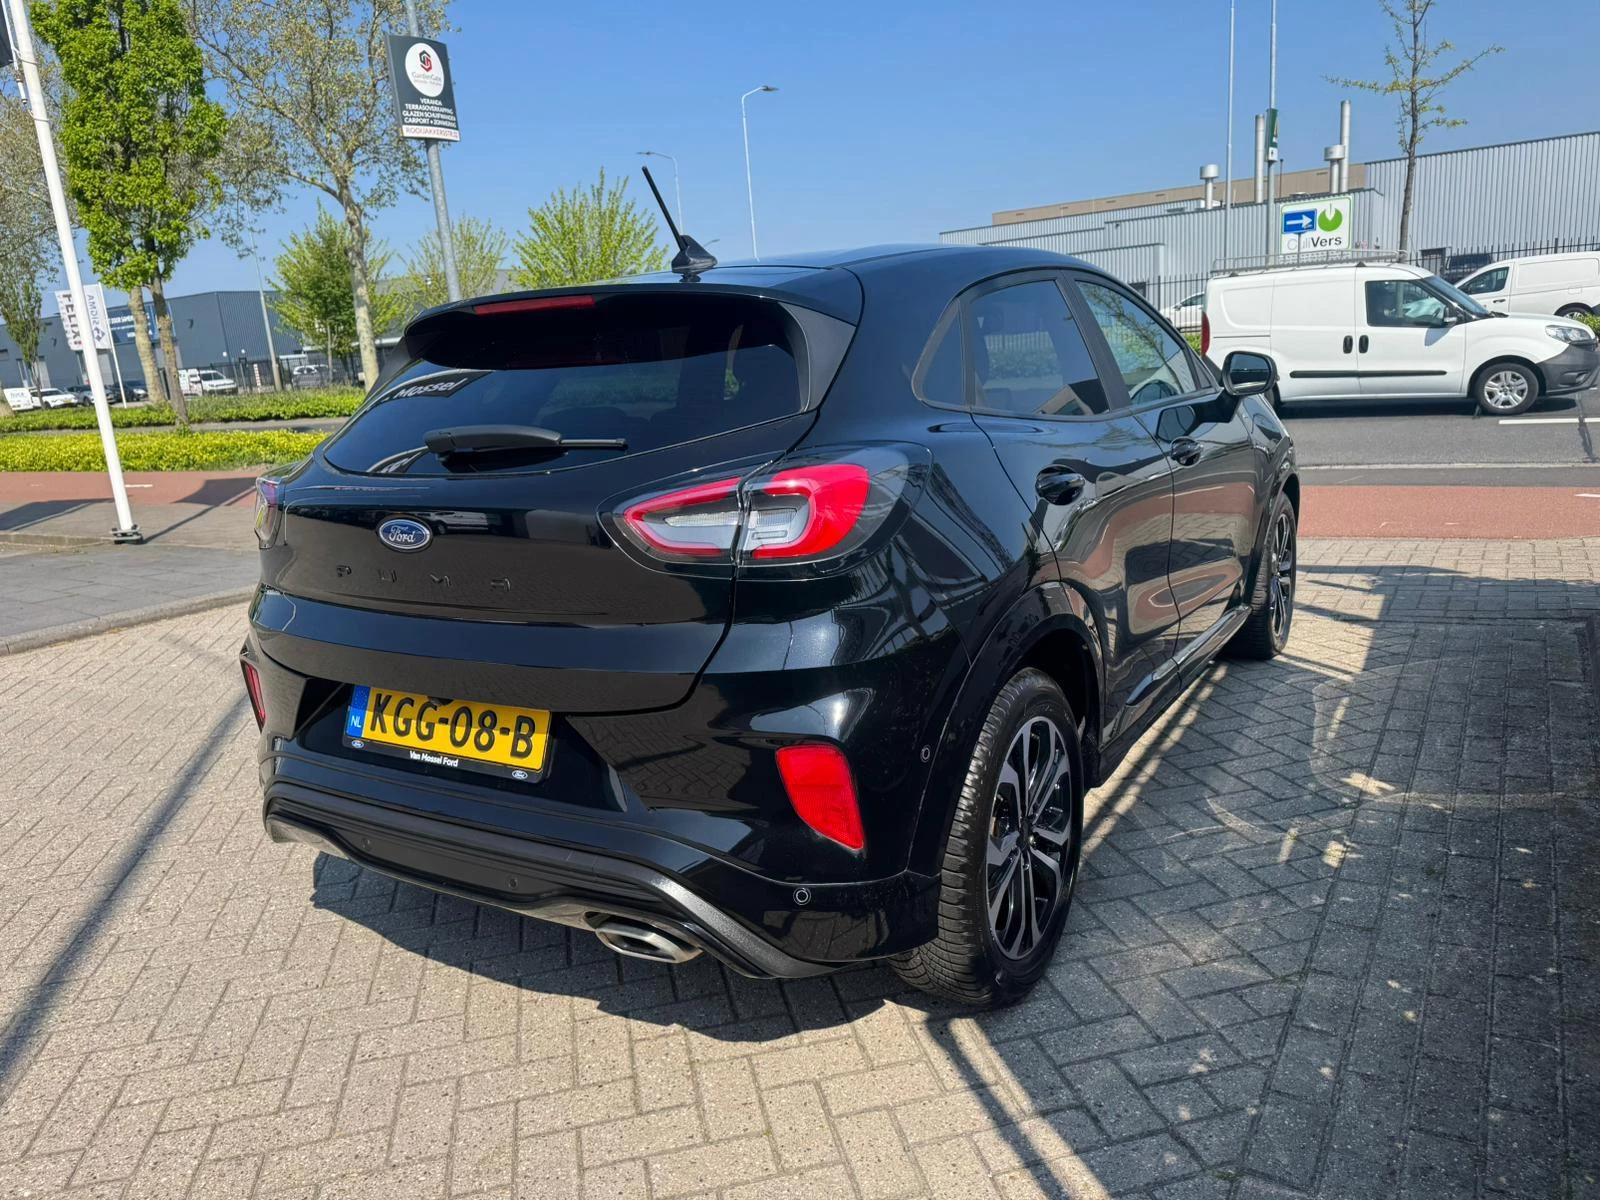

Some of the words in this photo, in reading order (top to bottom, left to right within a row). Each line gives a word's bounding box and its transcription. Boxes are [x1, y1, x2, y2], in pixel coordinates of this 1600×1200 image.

[336, 564, 512, 593] PUMA
[350, 714, 362, 729] NL
[370, 692, 536, 760] KGG-08-B
[409, 750, 421, 760] Van
[421, 753, 443, 765] Mossel
[443, 756, 459, 767] Ford
